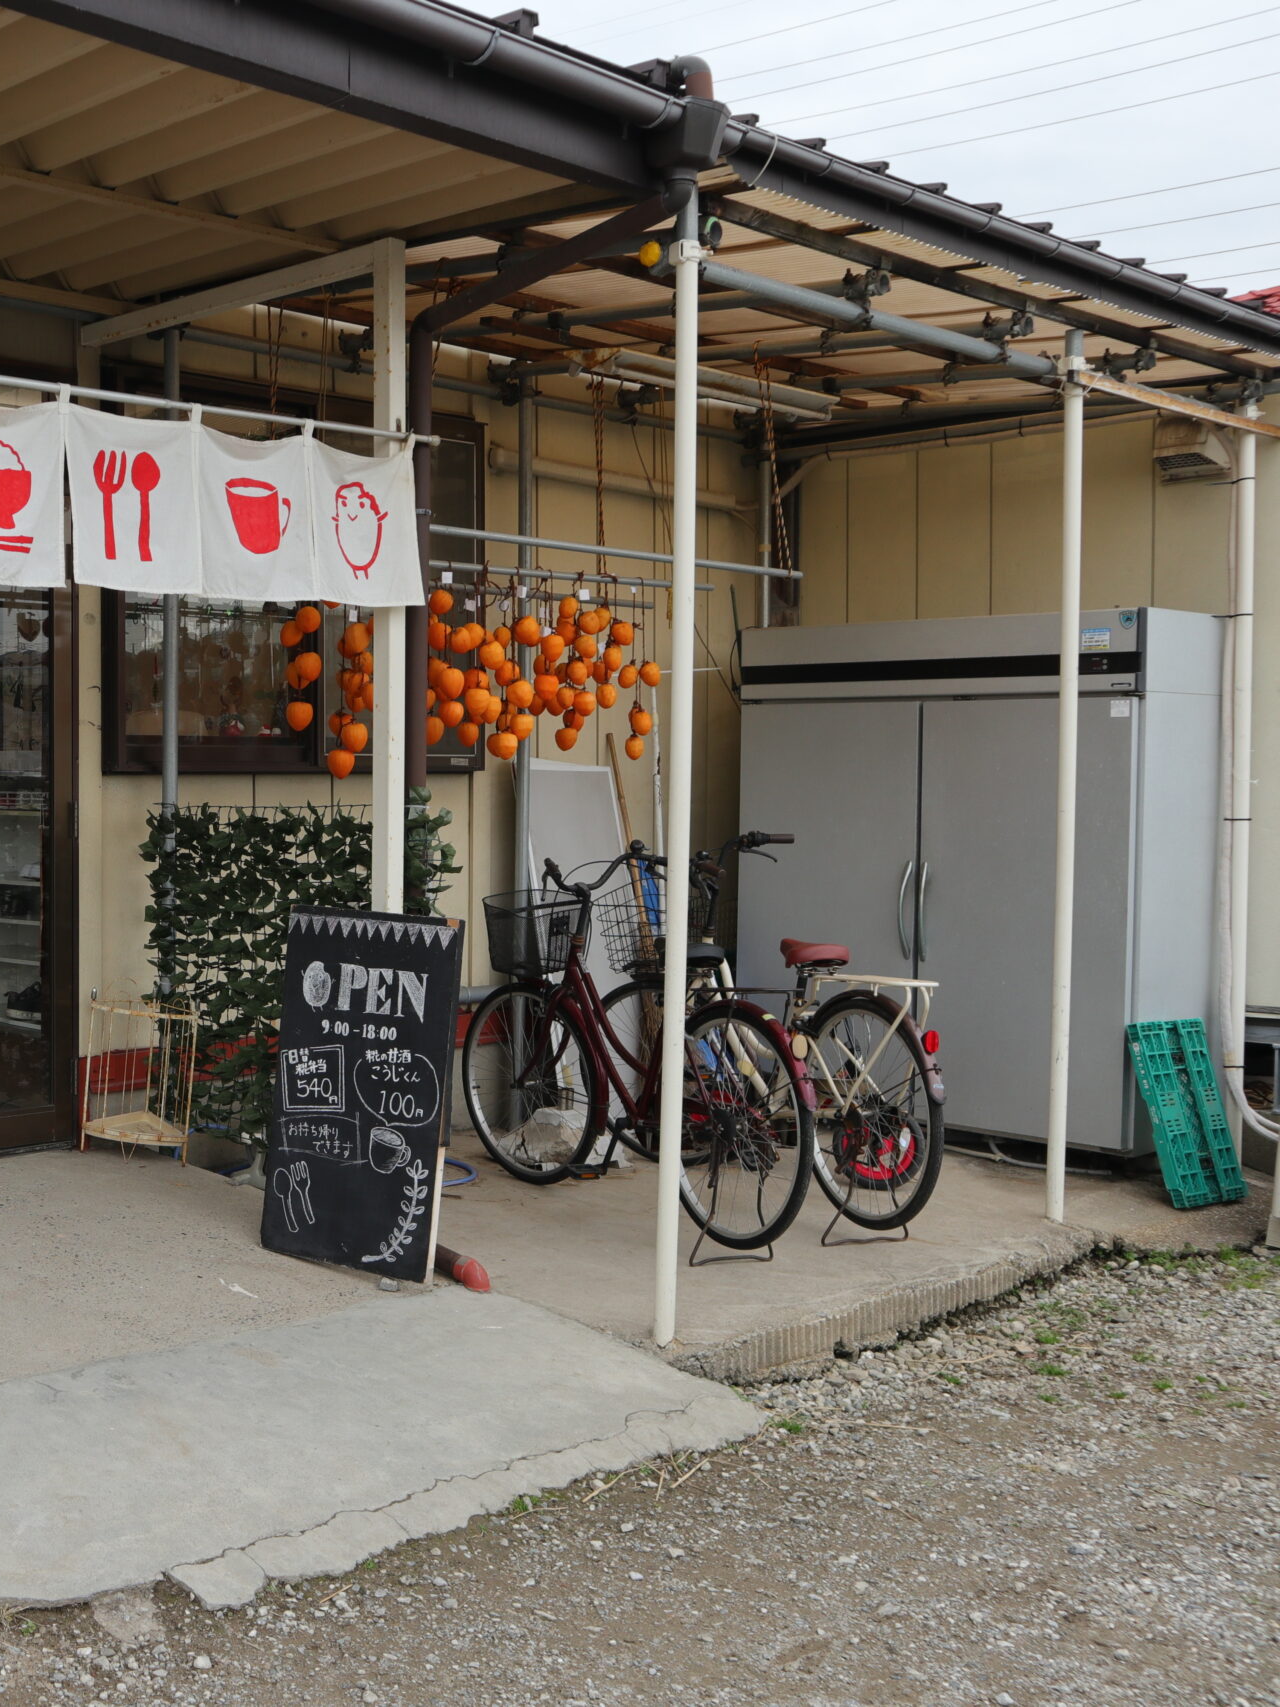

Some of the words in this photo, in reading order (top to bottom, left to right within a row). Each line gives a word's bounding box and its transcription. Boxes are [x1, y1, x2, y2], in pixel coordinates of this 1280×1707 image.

[288, 1048, 310, 1065] 日替
[370, 1064, 421, 1083] こうじくん
[288, 1121, 339, 1139] お持ち帰り
[312, 1140, 354, 1159] できます
